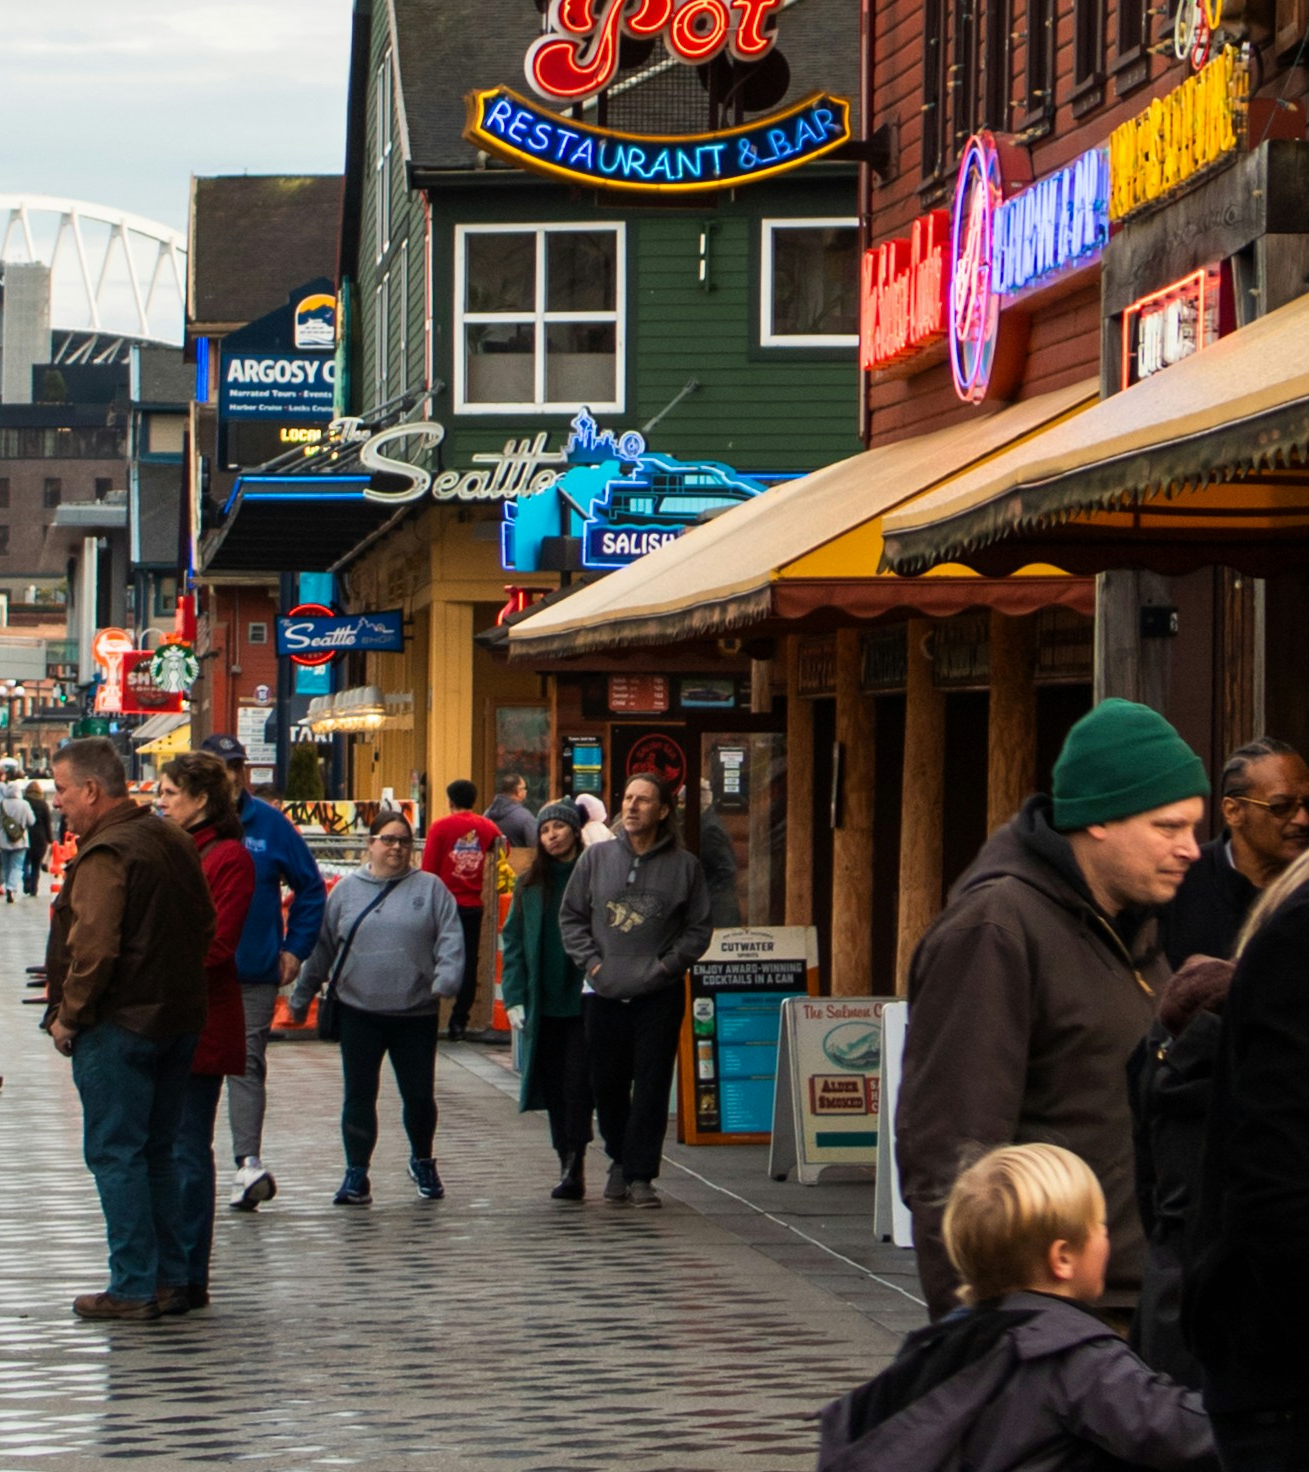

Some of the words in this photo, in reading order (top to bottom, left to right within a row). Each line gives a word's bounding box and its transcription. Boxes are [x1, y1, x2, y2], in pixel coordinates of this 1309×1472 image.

[487, 98, 726, 182] RESTAURANT
[736, 138, 772, 169] &
[769, 107, 840, 158] BAR
[227, 359, 320, 384] ARGOSY
[229, 389, 270, 398] Narrated
[272, 389, 297, 398] Tours
[304, 390, 332, 399] Events
[229, 404, 256, 412] Harbor
[258, 404, 283, 412] Cruise
[288, 404, 310, 412] Locks
[329, 416, 372, 444] The
[360, 422, 570, 504] Seattle
[284, 622, 358, 649] Seattle
[361, 636, 395, 644] SHOP
[721, 942, 775, 953] CUTWATER
[693, 964, 723, 975] ENJOY
[725, 962, 803, 974] AWARD-WINNING
[703, 974, 752, 986] COCKTAILS
[754, 974, 765, 985] IN
[766, 974, 774, 984] A
[775, 973, 794, 984] CAN
[803, 1004, 824, 1019] The
[826, 1004, 871, 1019] Salmon
